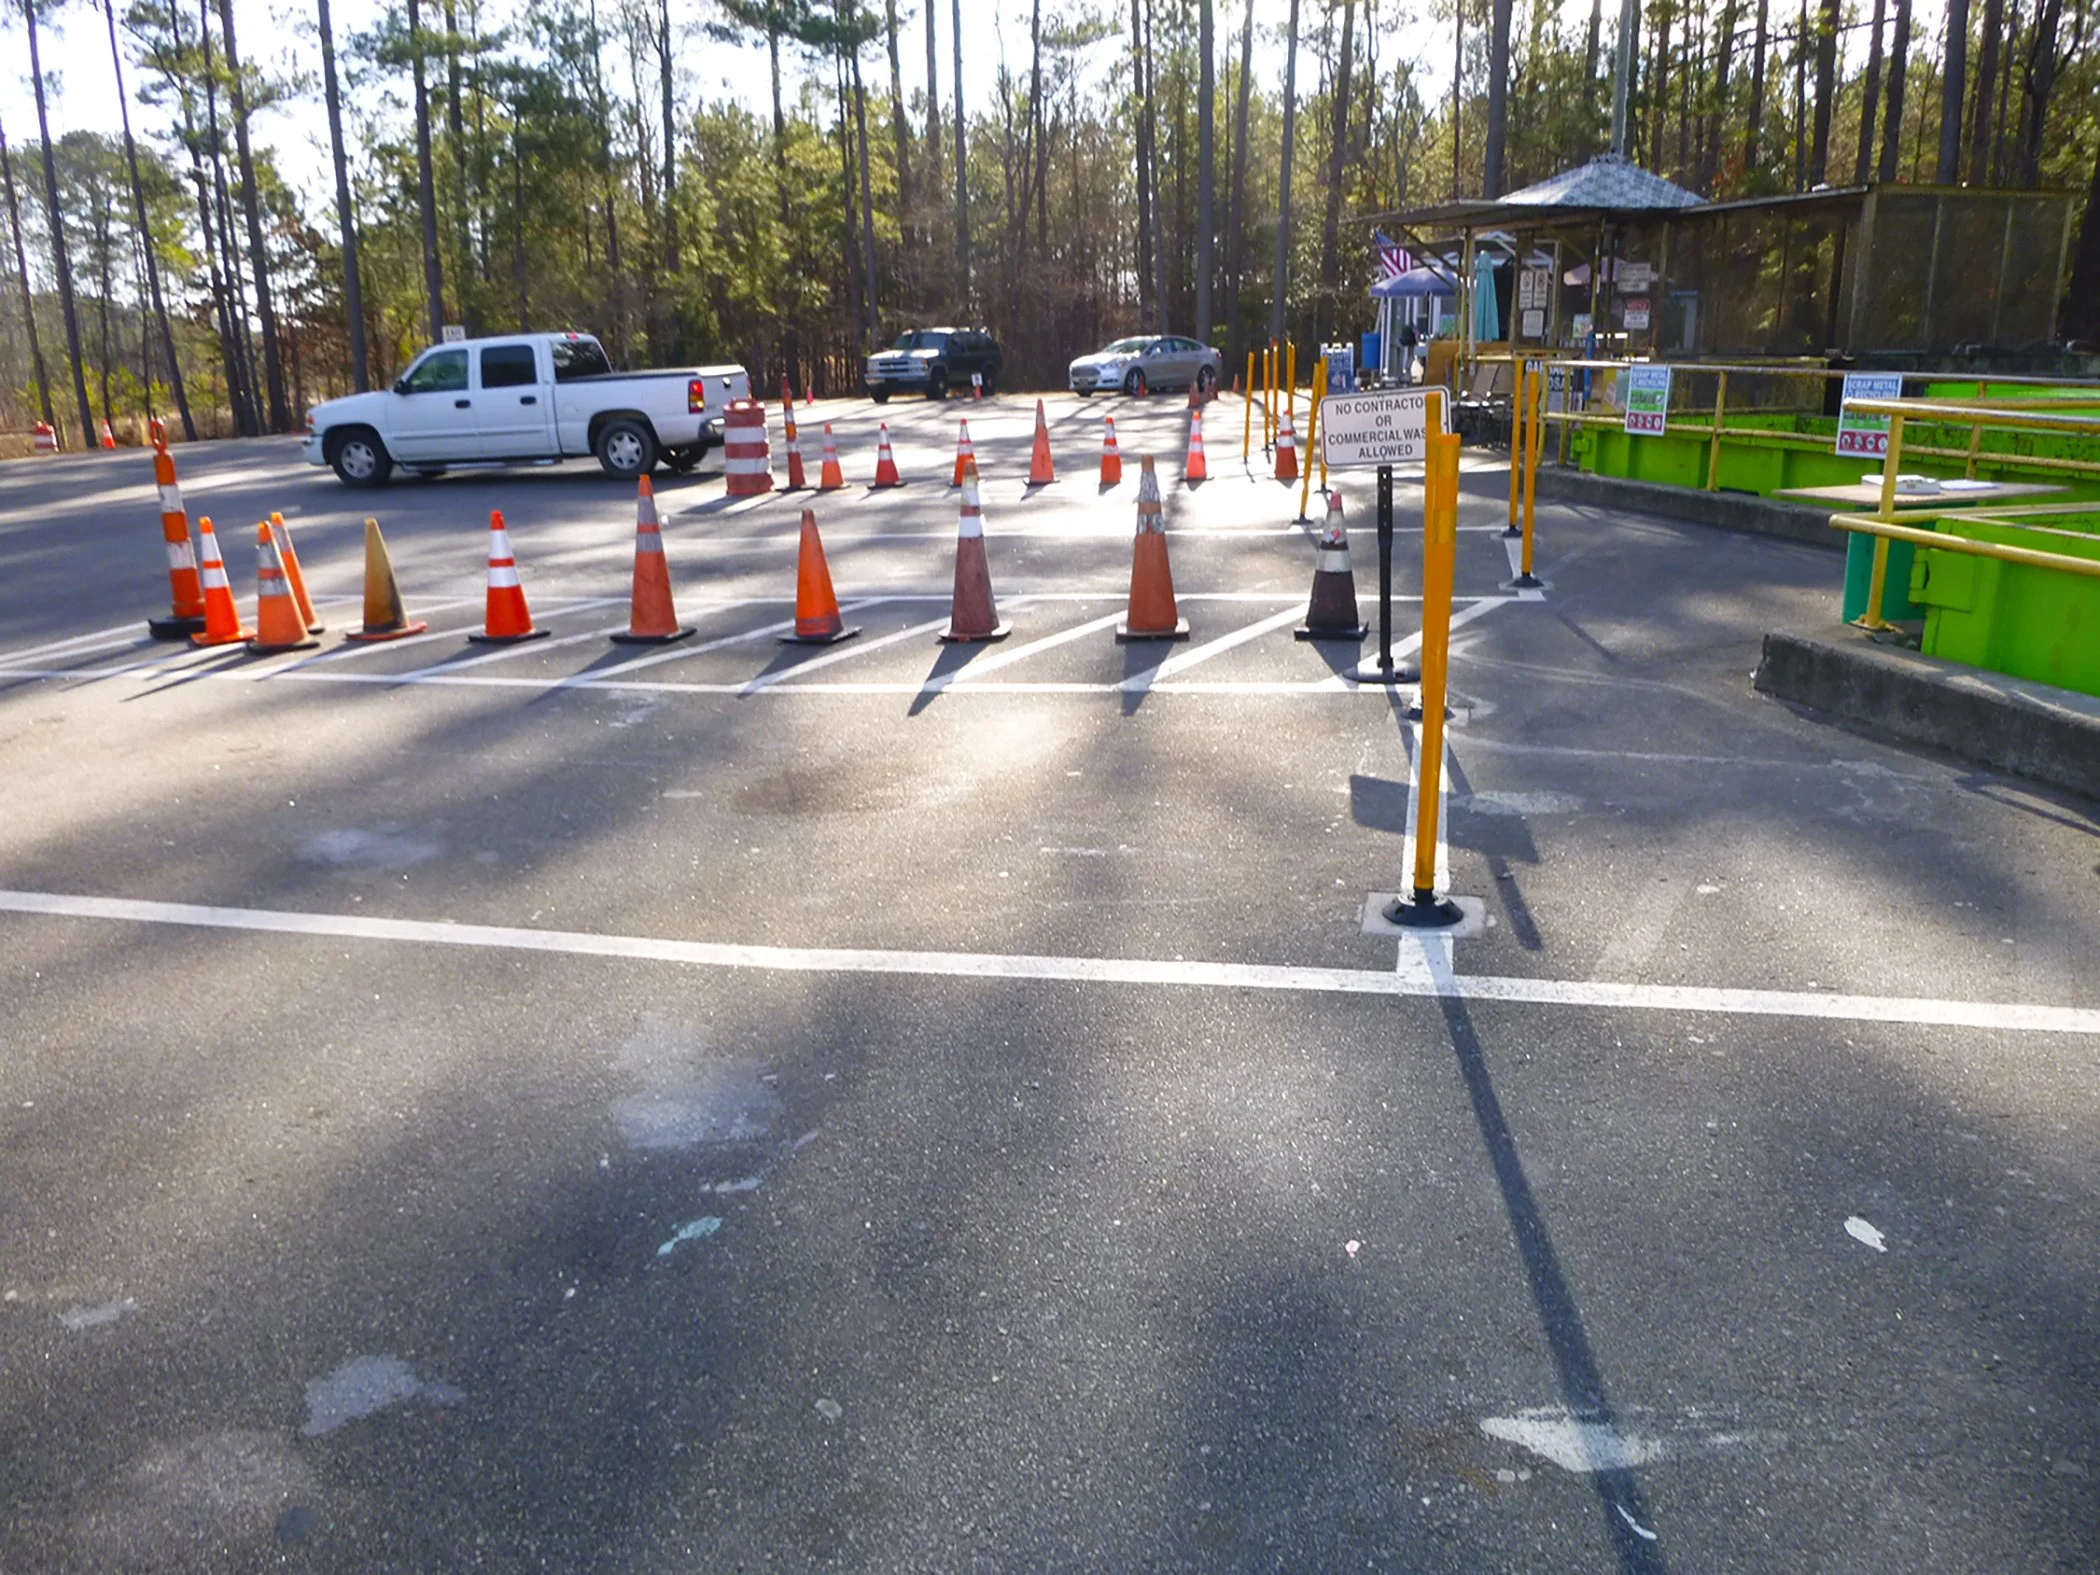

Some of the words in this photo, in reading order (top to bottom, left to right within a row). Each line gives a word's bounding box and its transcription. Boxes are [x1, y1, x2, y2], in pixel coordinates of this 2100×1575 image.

[1847, 379, 1872, 390] SCRAP
[1872, 379, 1897, 390] METAL
[1336, 402, 1351, 415] NO
[1355, 396, 1424, 413] CONTRACTO
[1375, 415, 1392, 427] OR
[1328, 430, 1402, 445] COMMERCIAL
[1359, 444, 1413, 459] ALLOWED
